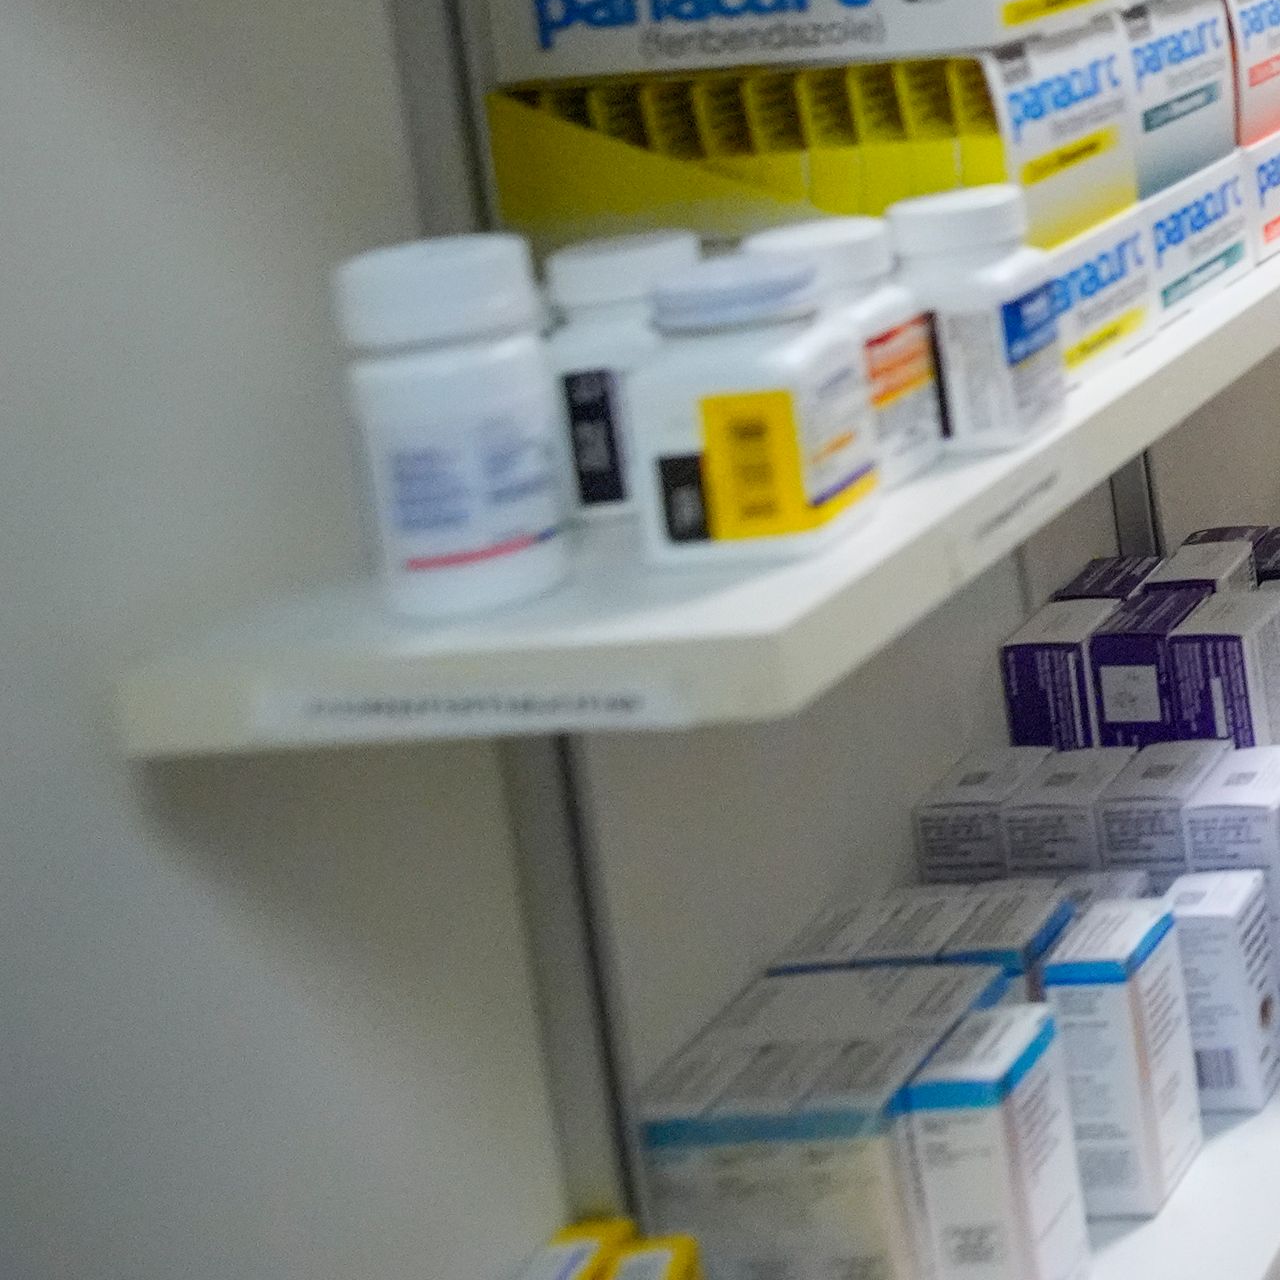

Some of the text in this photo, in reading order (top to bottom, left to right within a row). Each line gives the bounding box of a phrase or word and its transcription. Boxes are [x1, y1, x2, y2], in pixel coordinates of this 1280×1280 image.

[1131, 20, 1209, 92] panacur
[1007, 58, 1103, 144] panacur
[1153, 179, 1231, 269] panacur
